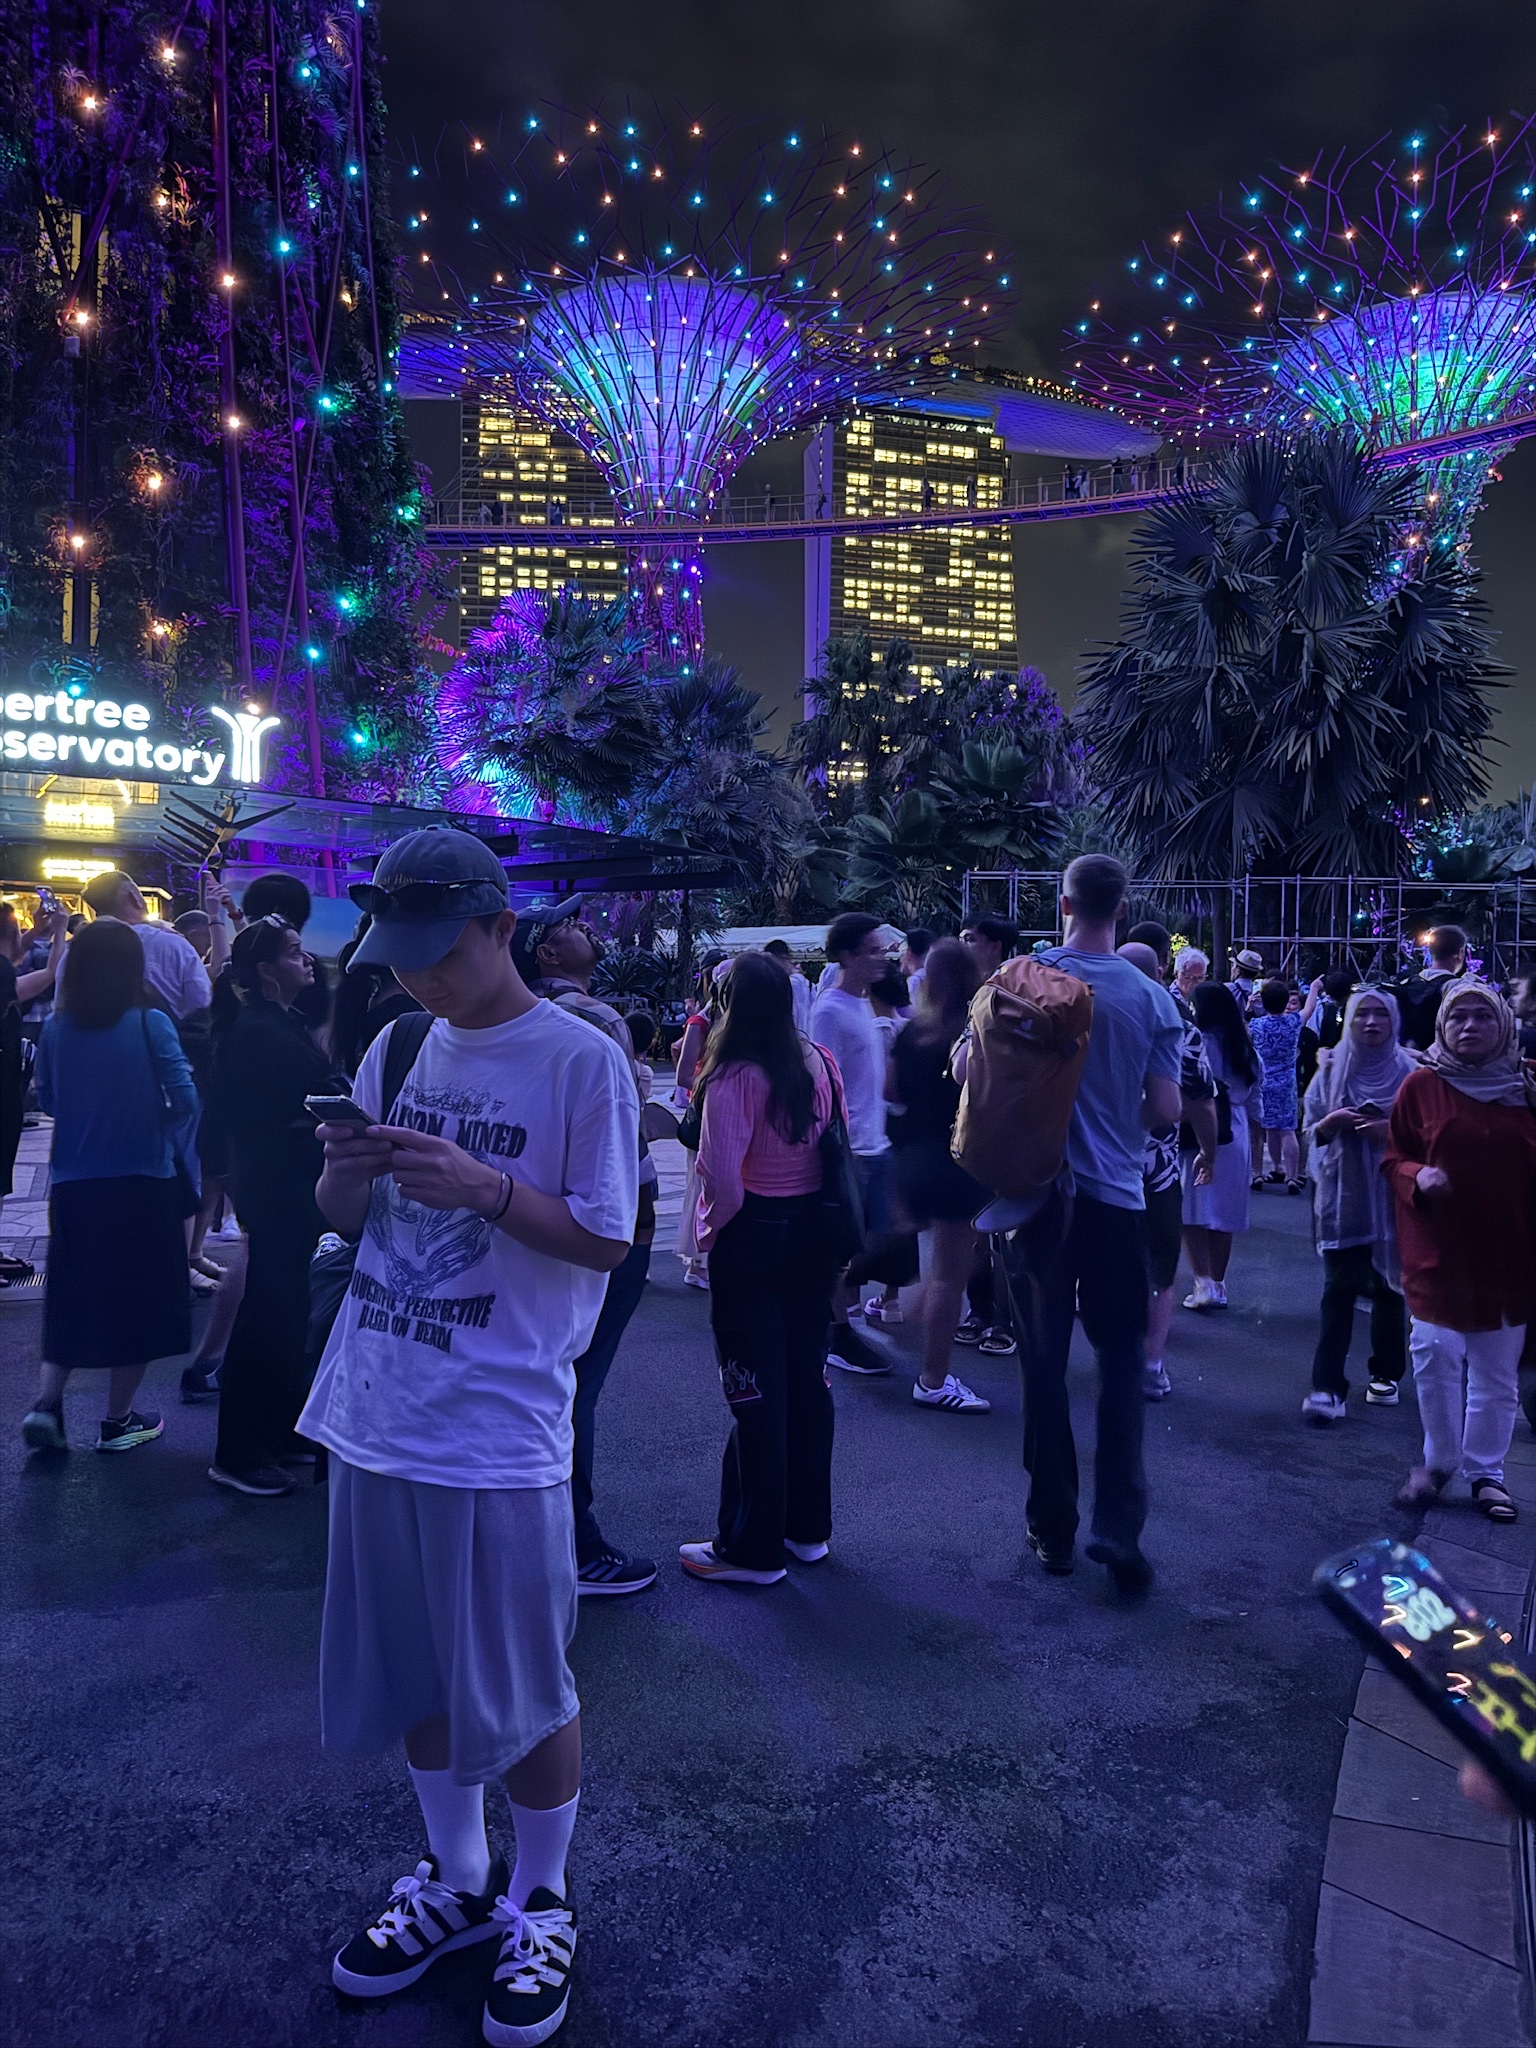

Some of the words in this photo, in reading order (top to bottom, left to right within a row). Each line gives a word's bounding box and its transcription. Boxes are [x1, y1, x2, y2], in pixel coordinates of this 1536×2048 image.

[0, 691, 150, 731] ertree
[0, 731, 226, 786] servatory
[391, 1315, 411, 1339] ON
[404, 1292, 496, 1329] PERSPECTIVE
